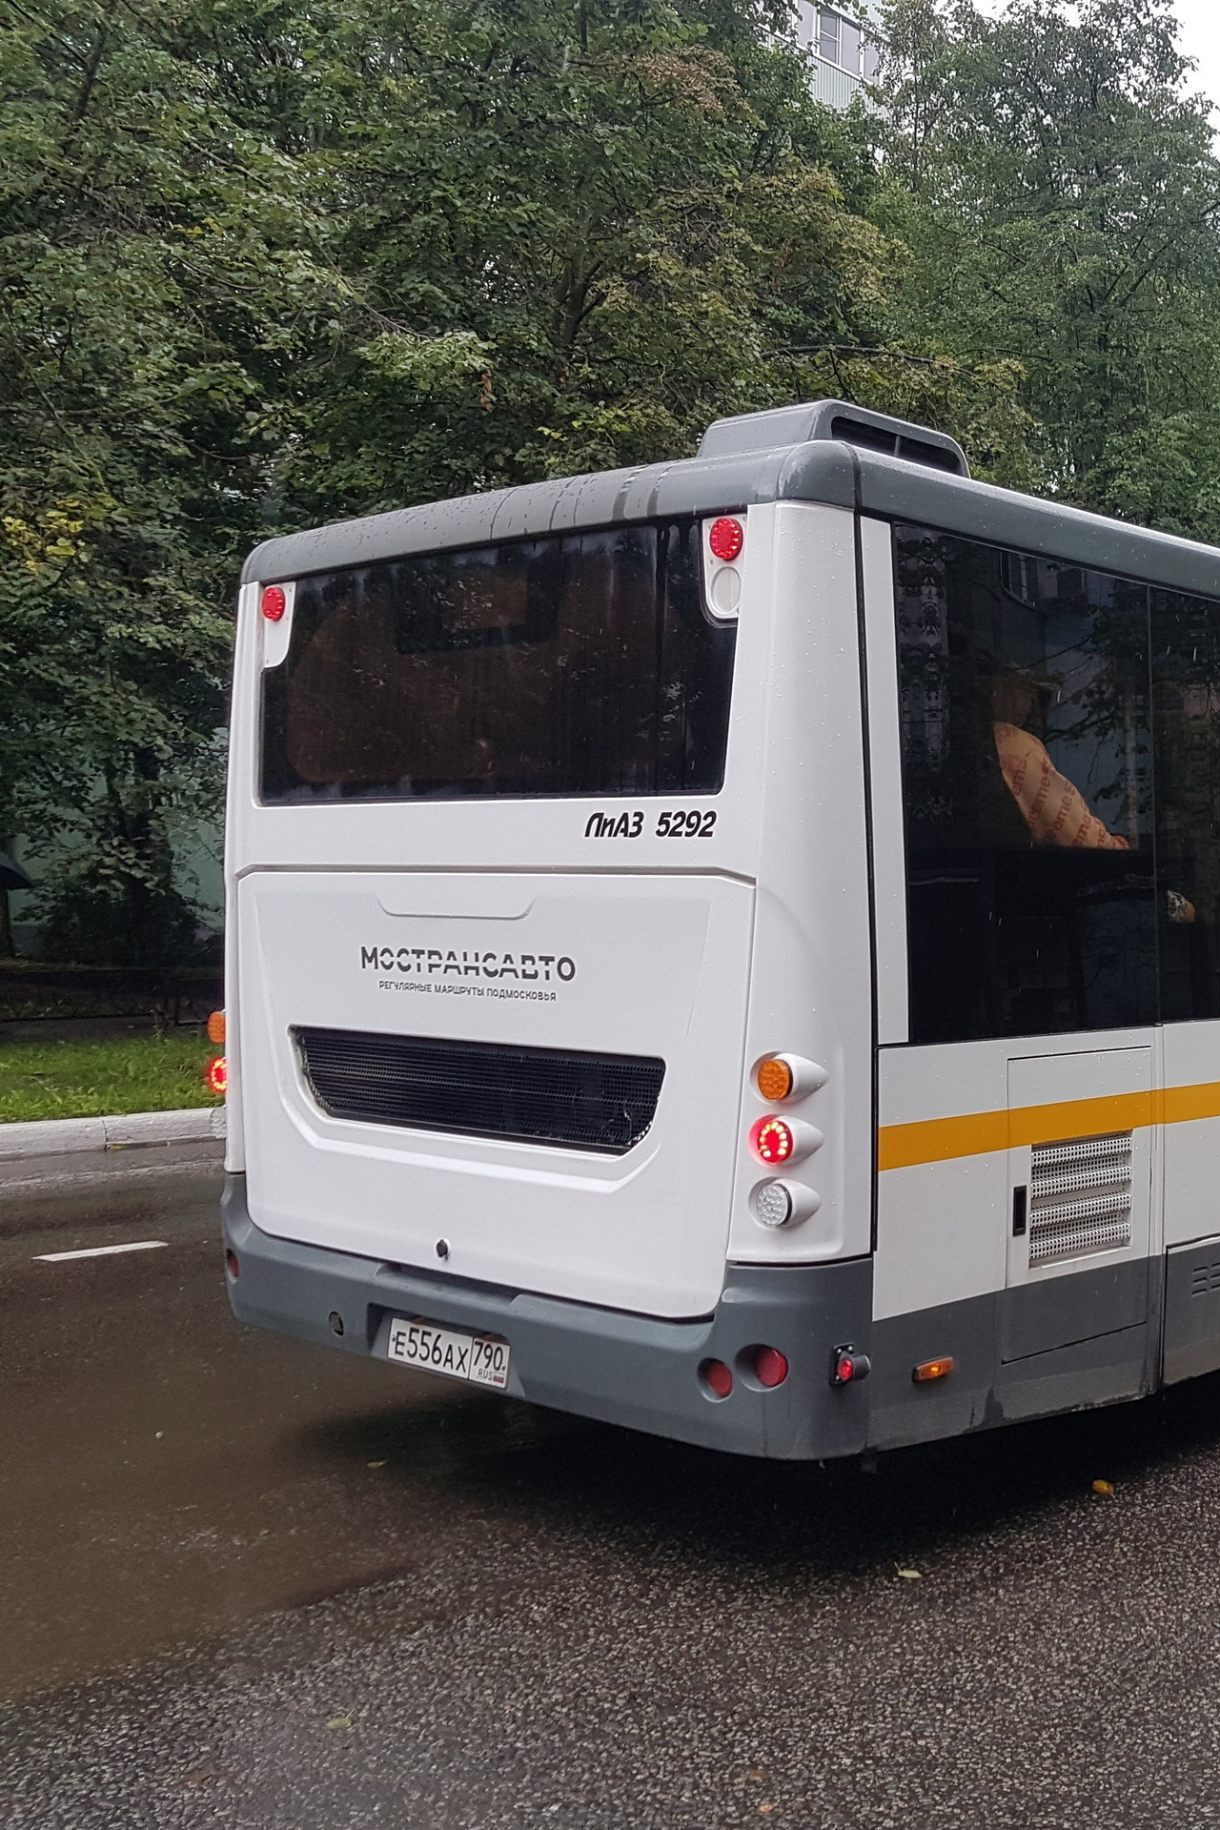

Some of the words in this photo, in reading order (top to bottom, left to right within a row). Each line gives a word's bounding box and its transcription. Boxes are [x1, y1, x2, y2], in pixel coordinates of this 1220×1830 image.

[584, 811, 645, 838] ЛиАЗ
[655, 810, 717, 838] 5292
[361, 946, 576, 981] МОСТРАНСАВТО
[379, 980, 432, 993] РЕГУЛЯРНЫЕ
[434, 984, 484, 997] МАРШРУТЫ
[486, 987, 557, 1001] ПОДМОСКОВЬЯ
[473, 1341, 504, 1371] 790
[477, 1368, 493, 1380] RUS
